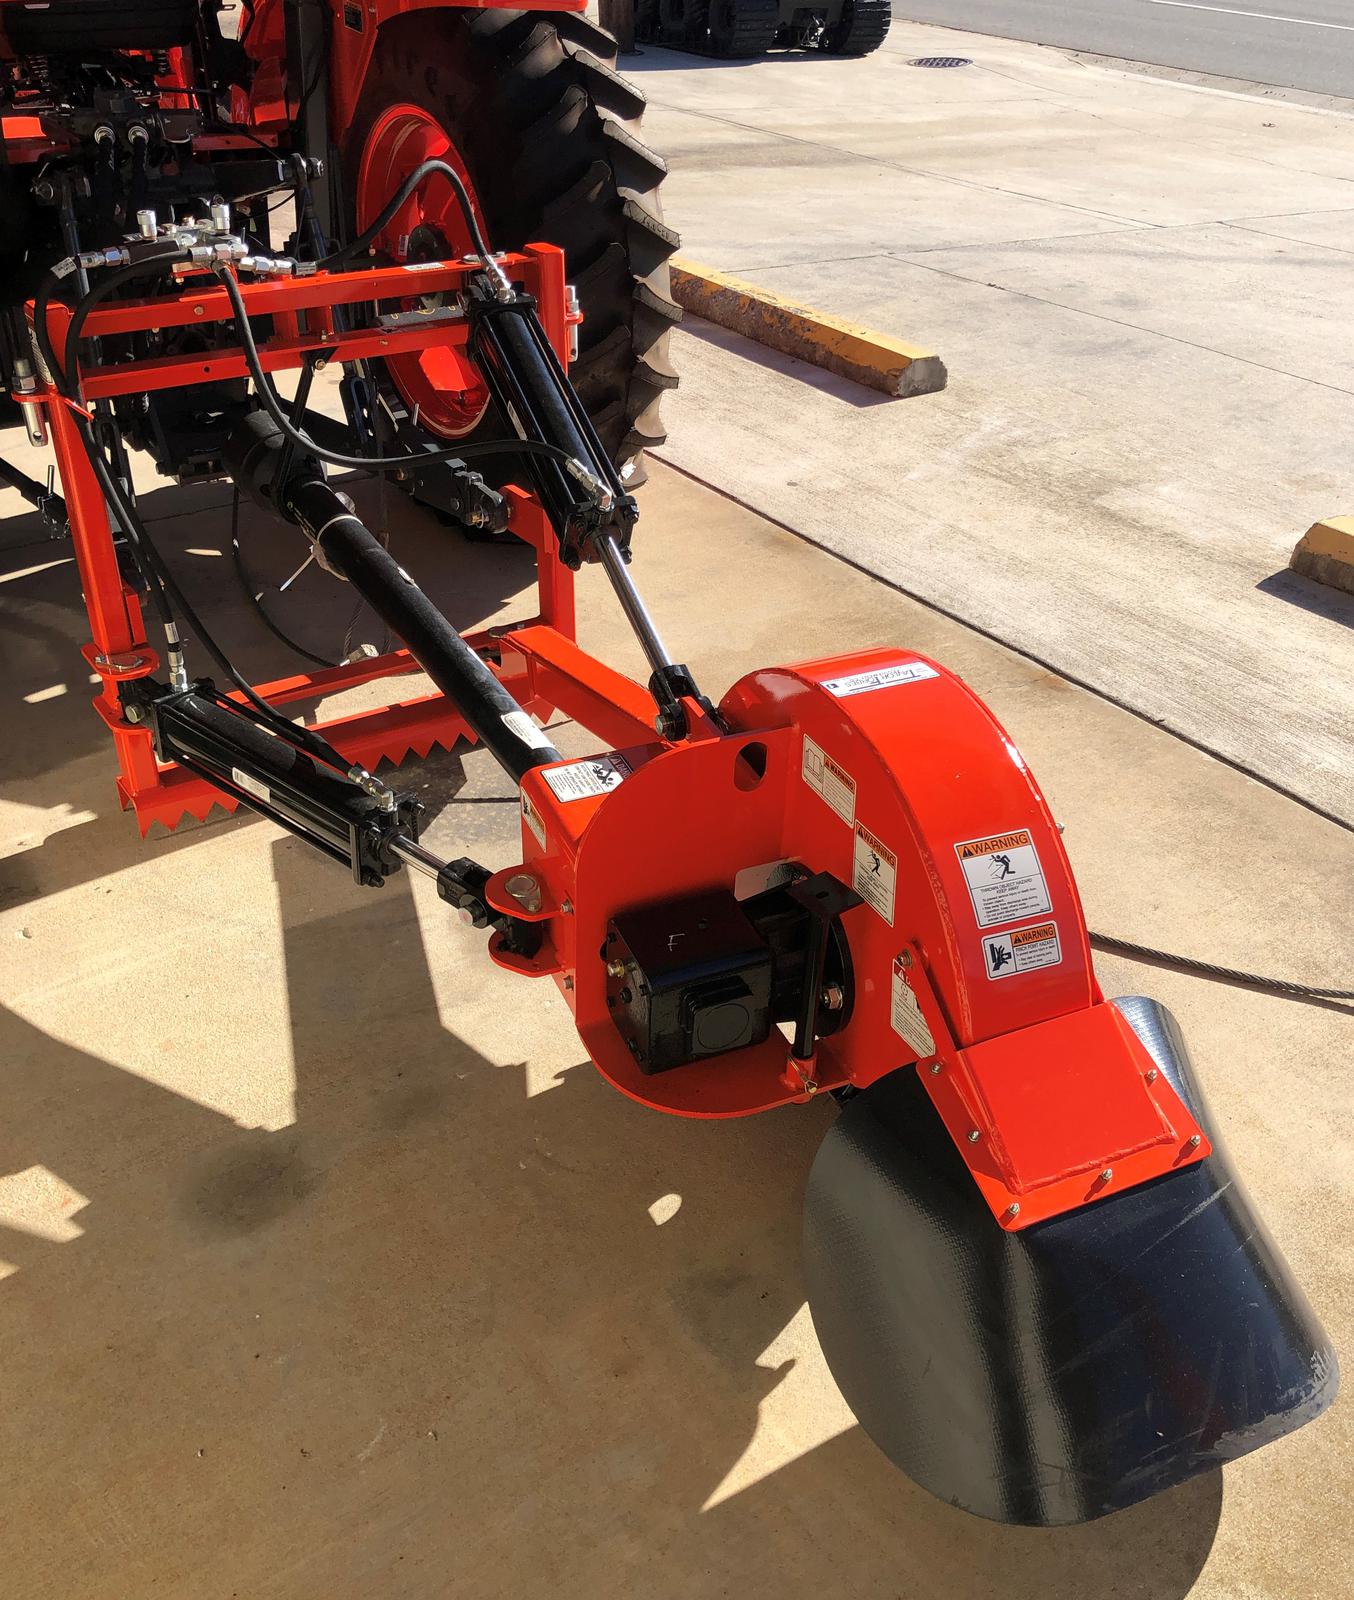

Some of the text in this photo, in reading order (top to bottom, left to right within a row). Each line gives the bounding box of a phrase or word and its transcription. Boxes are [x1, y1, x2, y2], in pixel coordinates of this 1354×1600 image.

[829, 764, 854, 791] WARNING
[863, 830, 895, 867] WARNING
[972, 833, 1028, 855] WARNING
[1021, 926, 1054, 942] WARNING
